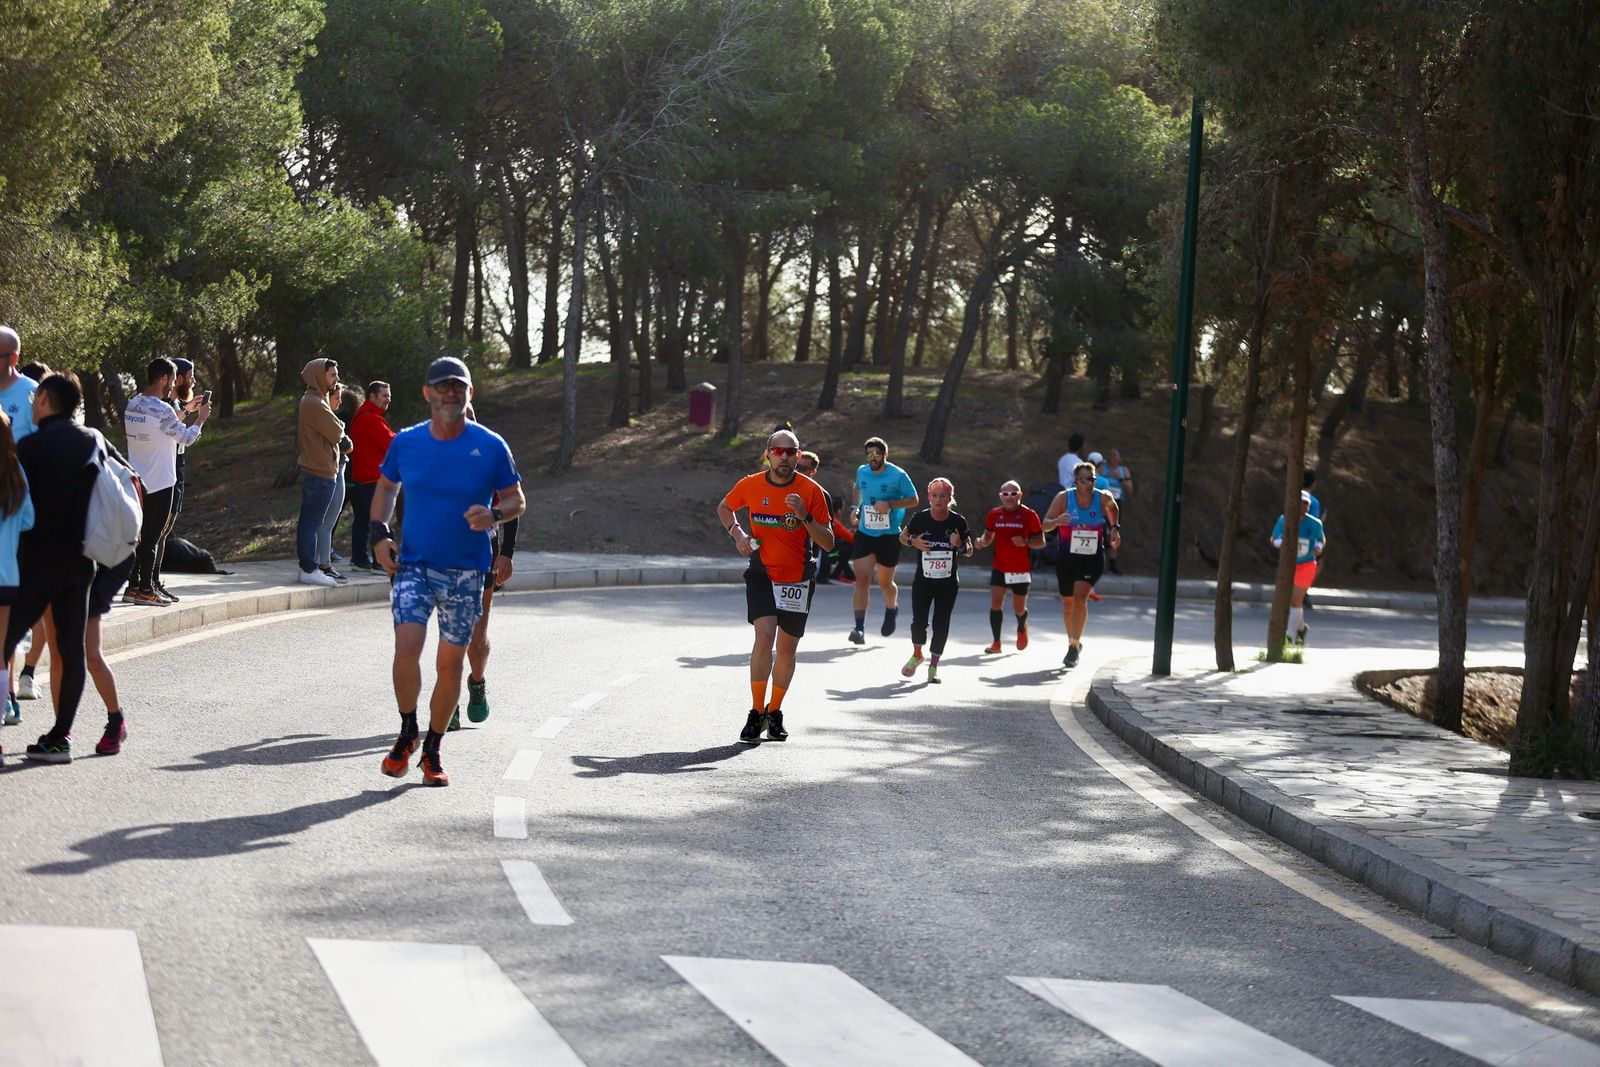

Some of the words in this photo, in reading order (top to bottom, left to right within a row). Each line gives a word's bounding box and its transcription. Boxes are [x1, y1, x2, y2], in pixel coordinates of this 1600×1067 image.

[869, 514, 884, 522] 176
[1080, 539, 1091, 547] 72
[929, 560, 947, 570] 784
[780, 587, 802, 600] 500
